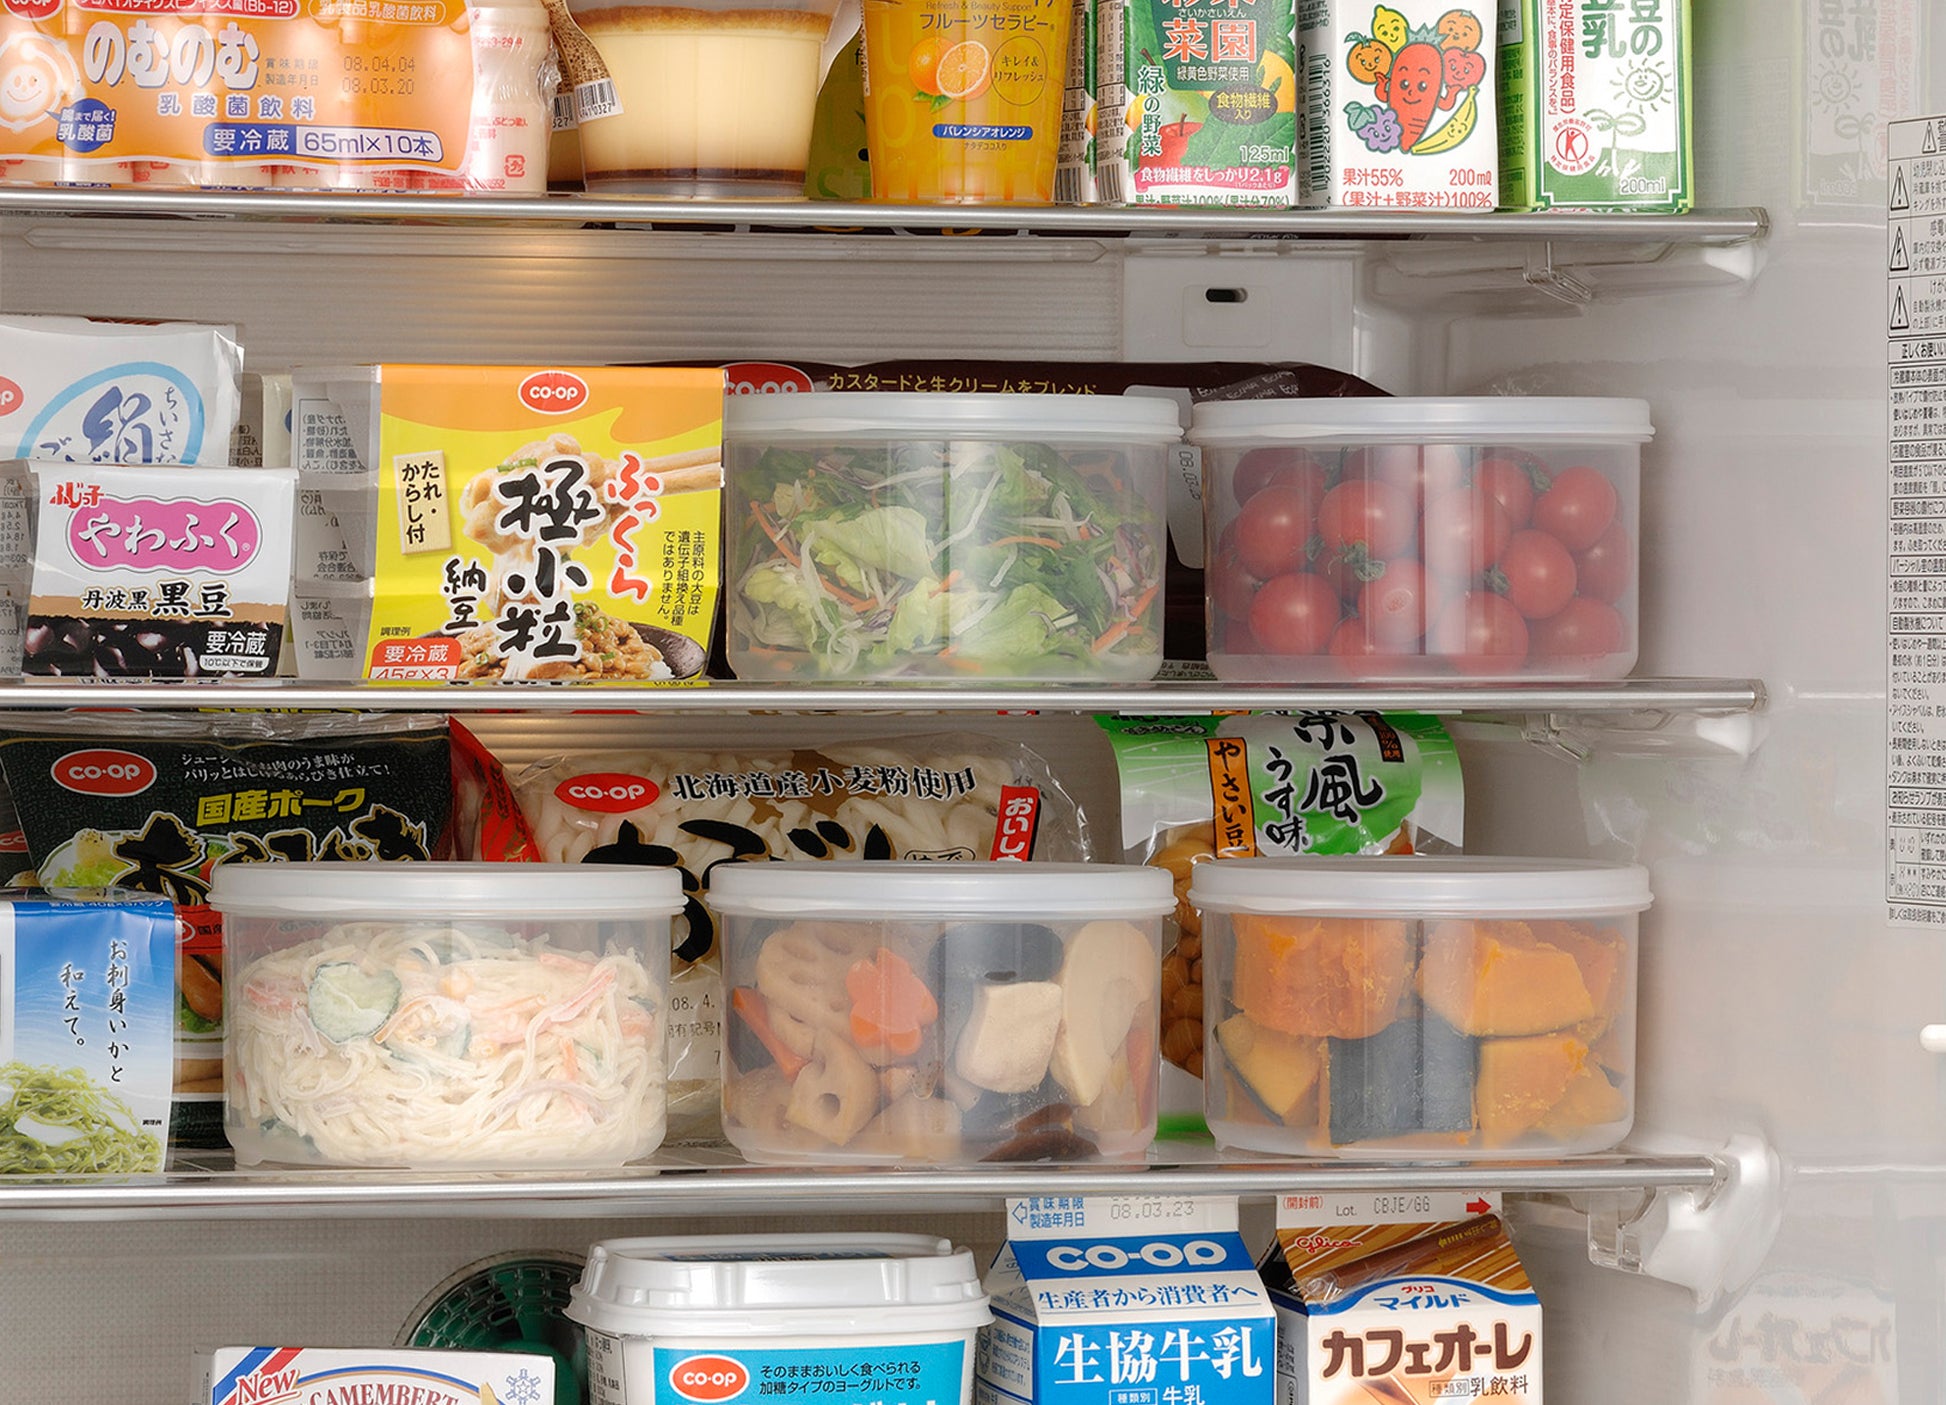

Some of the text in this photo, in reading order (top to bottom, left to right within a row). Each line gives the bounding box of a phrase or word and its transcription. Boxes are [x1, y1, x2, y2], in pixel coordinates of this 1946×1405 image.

[920, 13, 1048, 31] フルーツセラピー
[83, 20, 259, 89] のむのむ
[1161, 18, 1257, 63] 菜園
[342, 77, 415, 95] 08.03.20
[158, 93, 316, 119] 乳酸菌飲料
[1138, 65, 1166, 156] 緑の野菜
[213, 128, 289, 152] 要冷蔵
[303, 132, 435, 157] 65ml×10本
[943, 126, 1027, 138] バレンシアオレンジ
[1240, 146, 1290, 163] 125ml
[1343, 168, 1404, 187] 果汁55%
[1620, 178, 1665, 194] 200ml
[401, 463, 426, 544] からし付
[79, 512, 239, 558] やわふく
[608, 453, 660, 600] ふっくら
[498, 459, 600, 659] 極小粒
[691, 530, 705, 616] 主原料の大豆は
[657, 530, 676, 622] ではありません。
[83, 581, 234, 618] 丹波黒 黒豆
[444, 558, 487, 630] 納豆
[206, 630, 269, 656] 要冷蔵
[380, 626, 411, 636] 調理例
[385, 645, 449, 663] 要冷蔵
[670, 766, 978, 802] 北海道産小麦粉使用
[1214, 742, 1249, 850] やさい豆
[196, 788, 366, 827] 国産ポーク
[1264, 746, 1310, 852] うす味
[60, 963, 86, 1048] 和えて。
[107, 940, 130, 1083] お刺身いかと
[1030, 1200, 1194, 1229] 製造年月日 08.03.23
[1336, 1205, 1357, 1217] Lot.
[1038, 1283, 1258, 1311] 生産者から消費者へ
[1374, 1293, 1472, 1310] マイルド
[1402, 1285, 1435, 1294] グリコ
[1053, 1326, 1263, 1385] 生協牛乳
[1322, 1322, 1533, 1378] カフェオーレ
[759, 1360, 922, 1379] そのままおいしく食べられる
[236, 1368, 299, 1402] New
[759, 1378, 922, 1396] 加糖タイプのヨーグルトです。
[1162, 1385, 1205, 1405] 牛乳
[1470, 1374, 1529, 1397] 乳飲料
